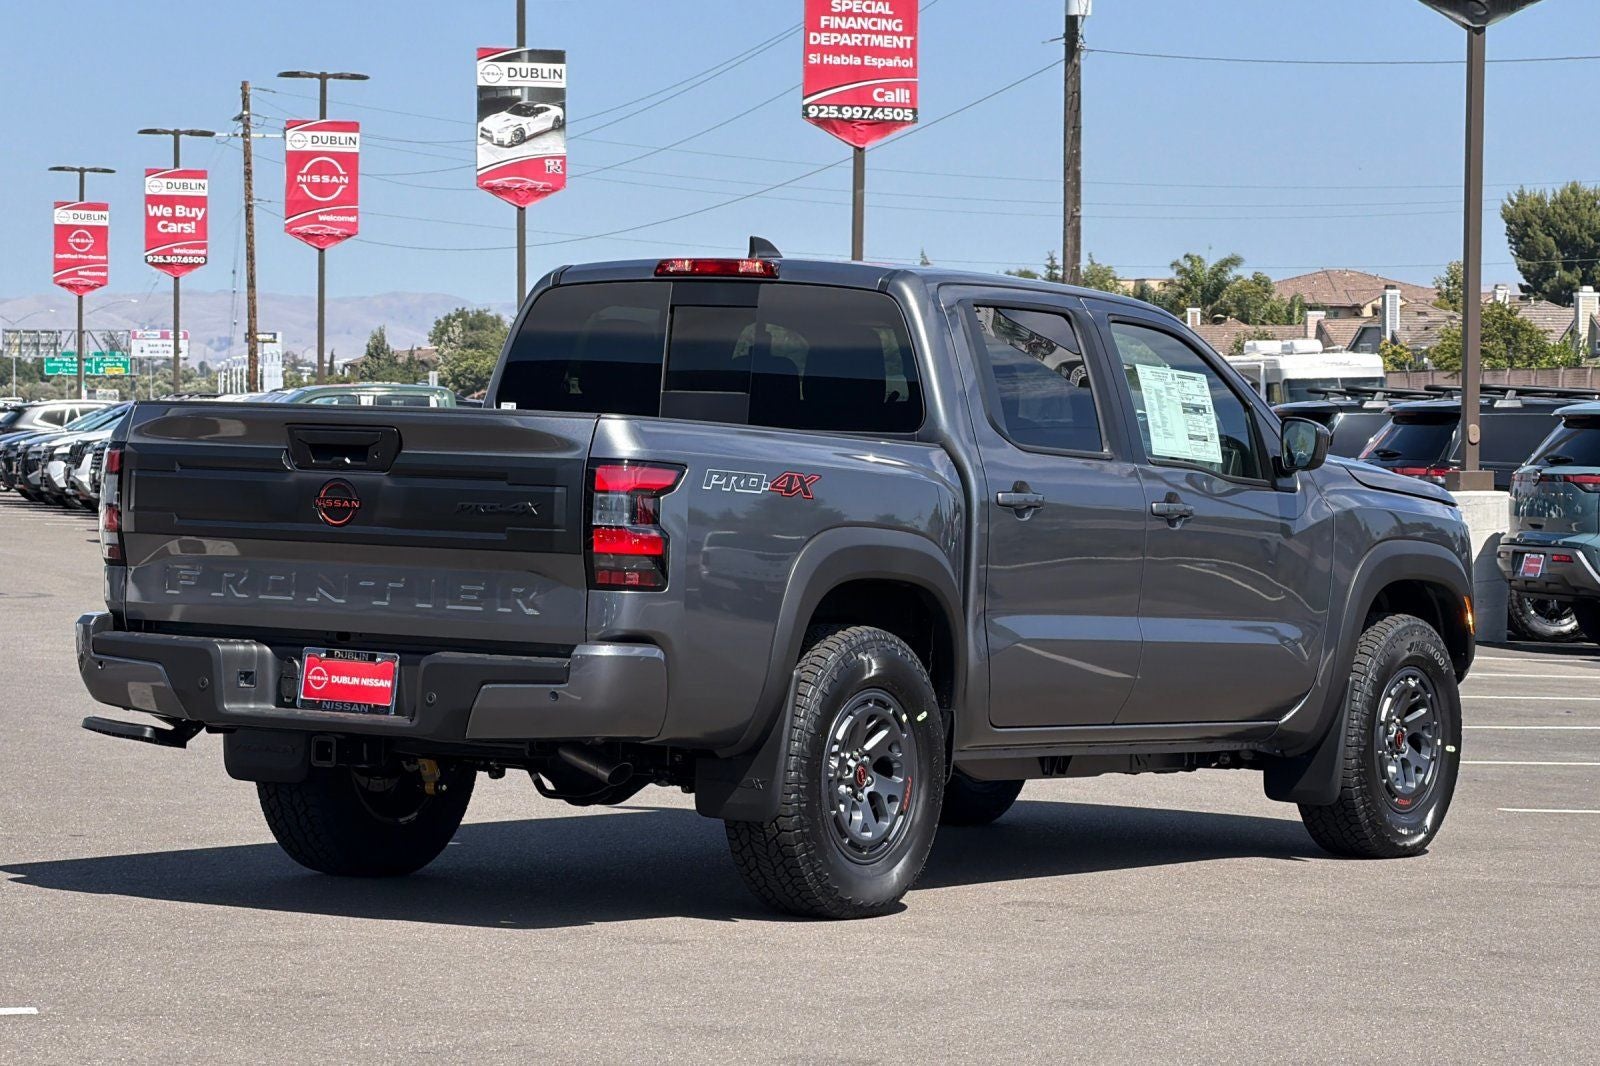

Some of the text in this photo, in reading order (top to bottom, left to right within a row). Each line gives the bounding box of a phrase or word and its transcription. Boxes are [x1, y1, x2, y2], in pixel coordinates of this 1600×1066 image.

[831, 0, 894, 15] SPECIAL
[820, 16, 903, 32] FINANCING
[809, 32, 914, 49] DEPARTMENT
[808, 53, 913, 69] Si Habla Español
[507, 67, 563, 80] DUBLIN
[872, 88, 911, 103] Call!
[807, 105, 914, 121] 925.997.4505
[311, 135, 357, 146] DUBLIN
[296, 174, 349, 184] NISSAN
[166, 181, 206, 191] DUBLIN
[72, 212, 107, 221] DUBLIN
[147, 204, 206, 220] We Buy
[318, 214, 357, 223] Welcome!
[157, 220, 196, 233] Cars!
[146, 255, 206, 264] 925.307.6500
[314, 498, 361, 508] NISSAN
[164, 564, 541, 615] FRONTIER
[333, 650, 369, 661] DUBLIN
[331, 675, 392, 688] DUBLIN NISSAN
[321, 701, 369, 713] NISSAN
